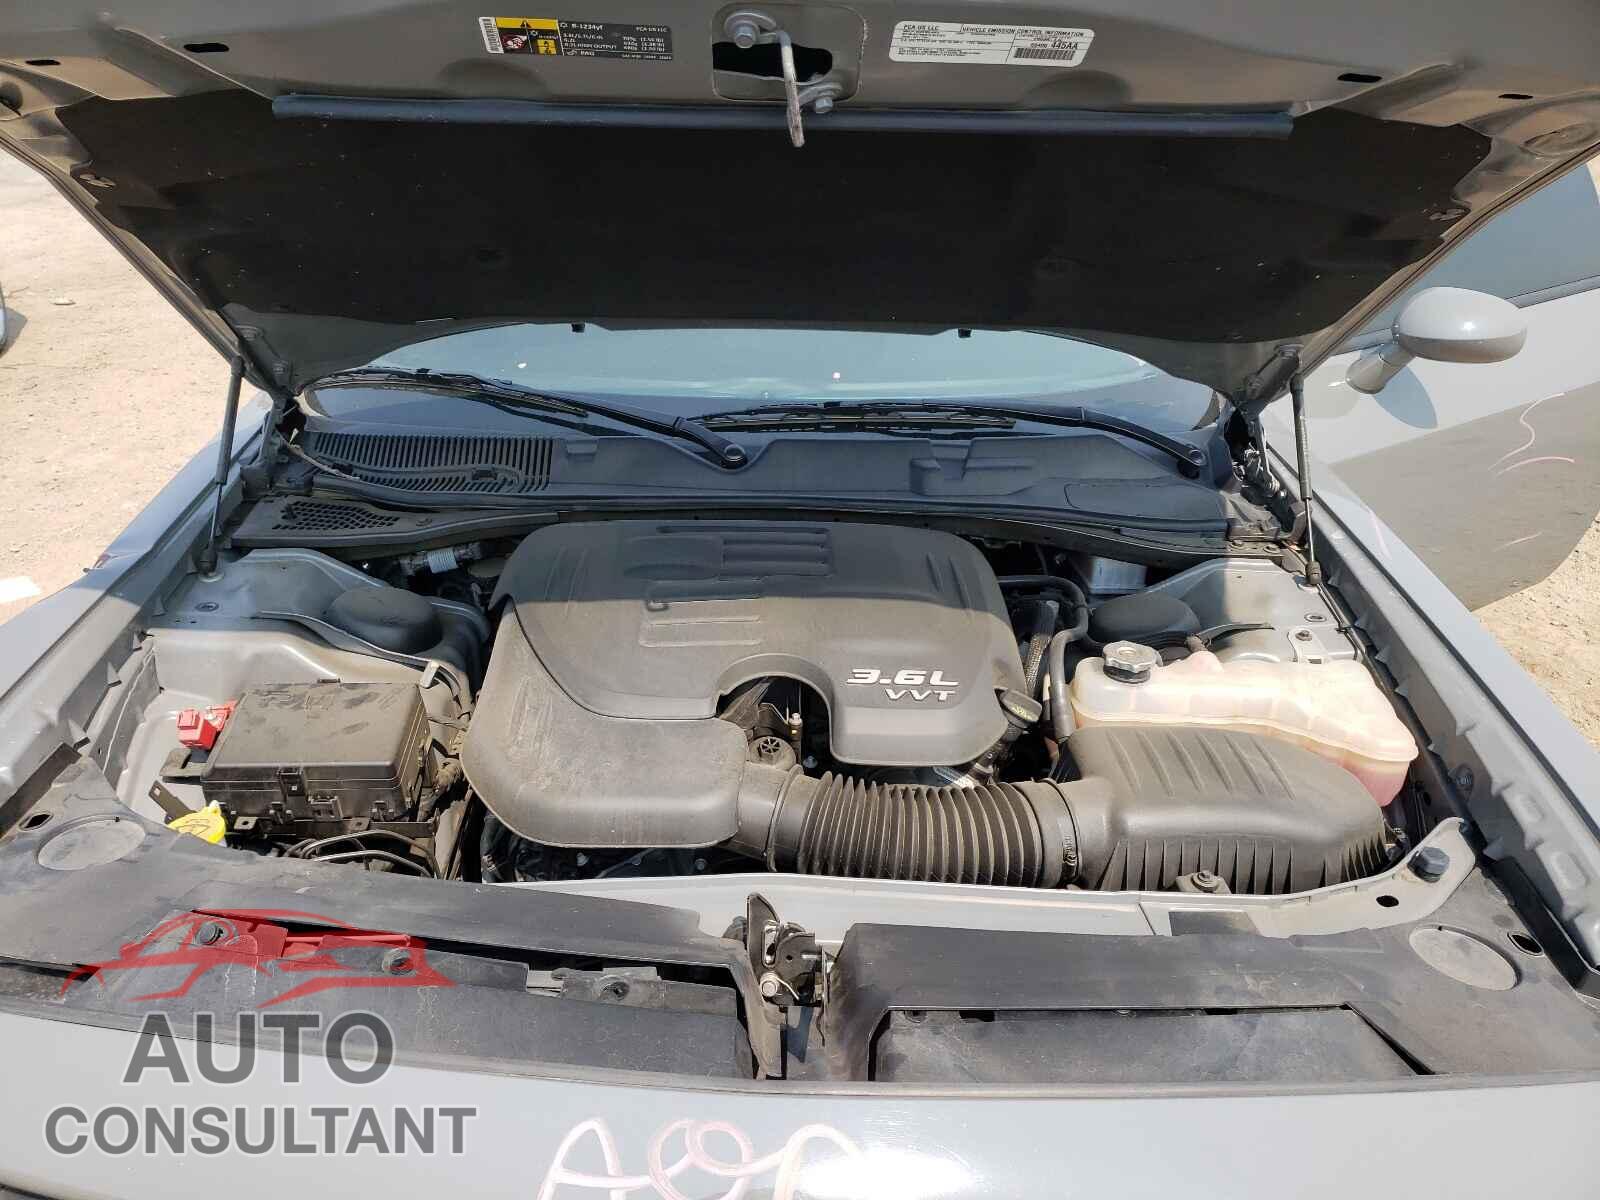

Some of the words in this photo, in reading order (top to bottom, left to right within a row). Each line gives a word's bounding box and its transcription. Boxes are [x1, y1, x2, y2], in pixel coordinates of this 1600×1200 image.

[1051, 41, 1079, 50] 445AA
[846, 668, 960, 687] 3.6L
[885, 688, 957, 702] VVT
